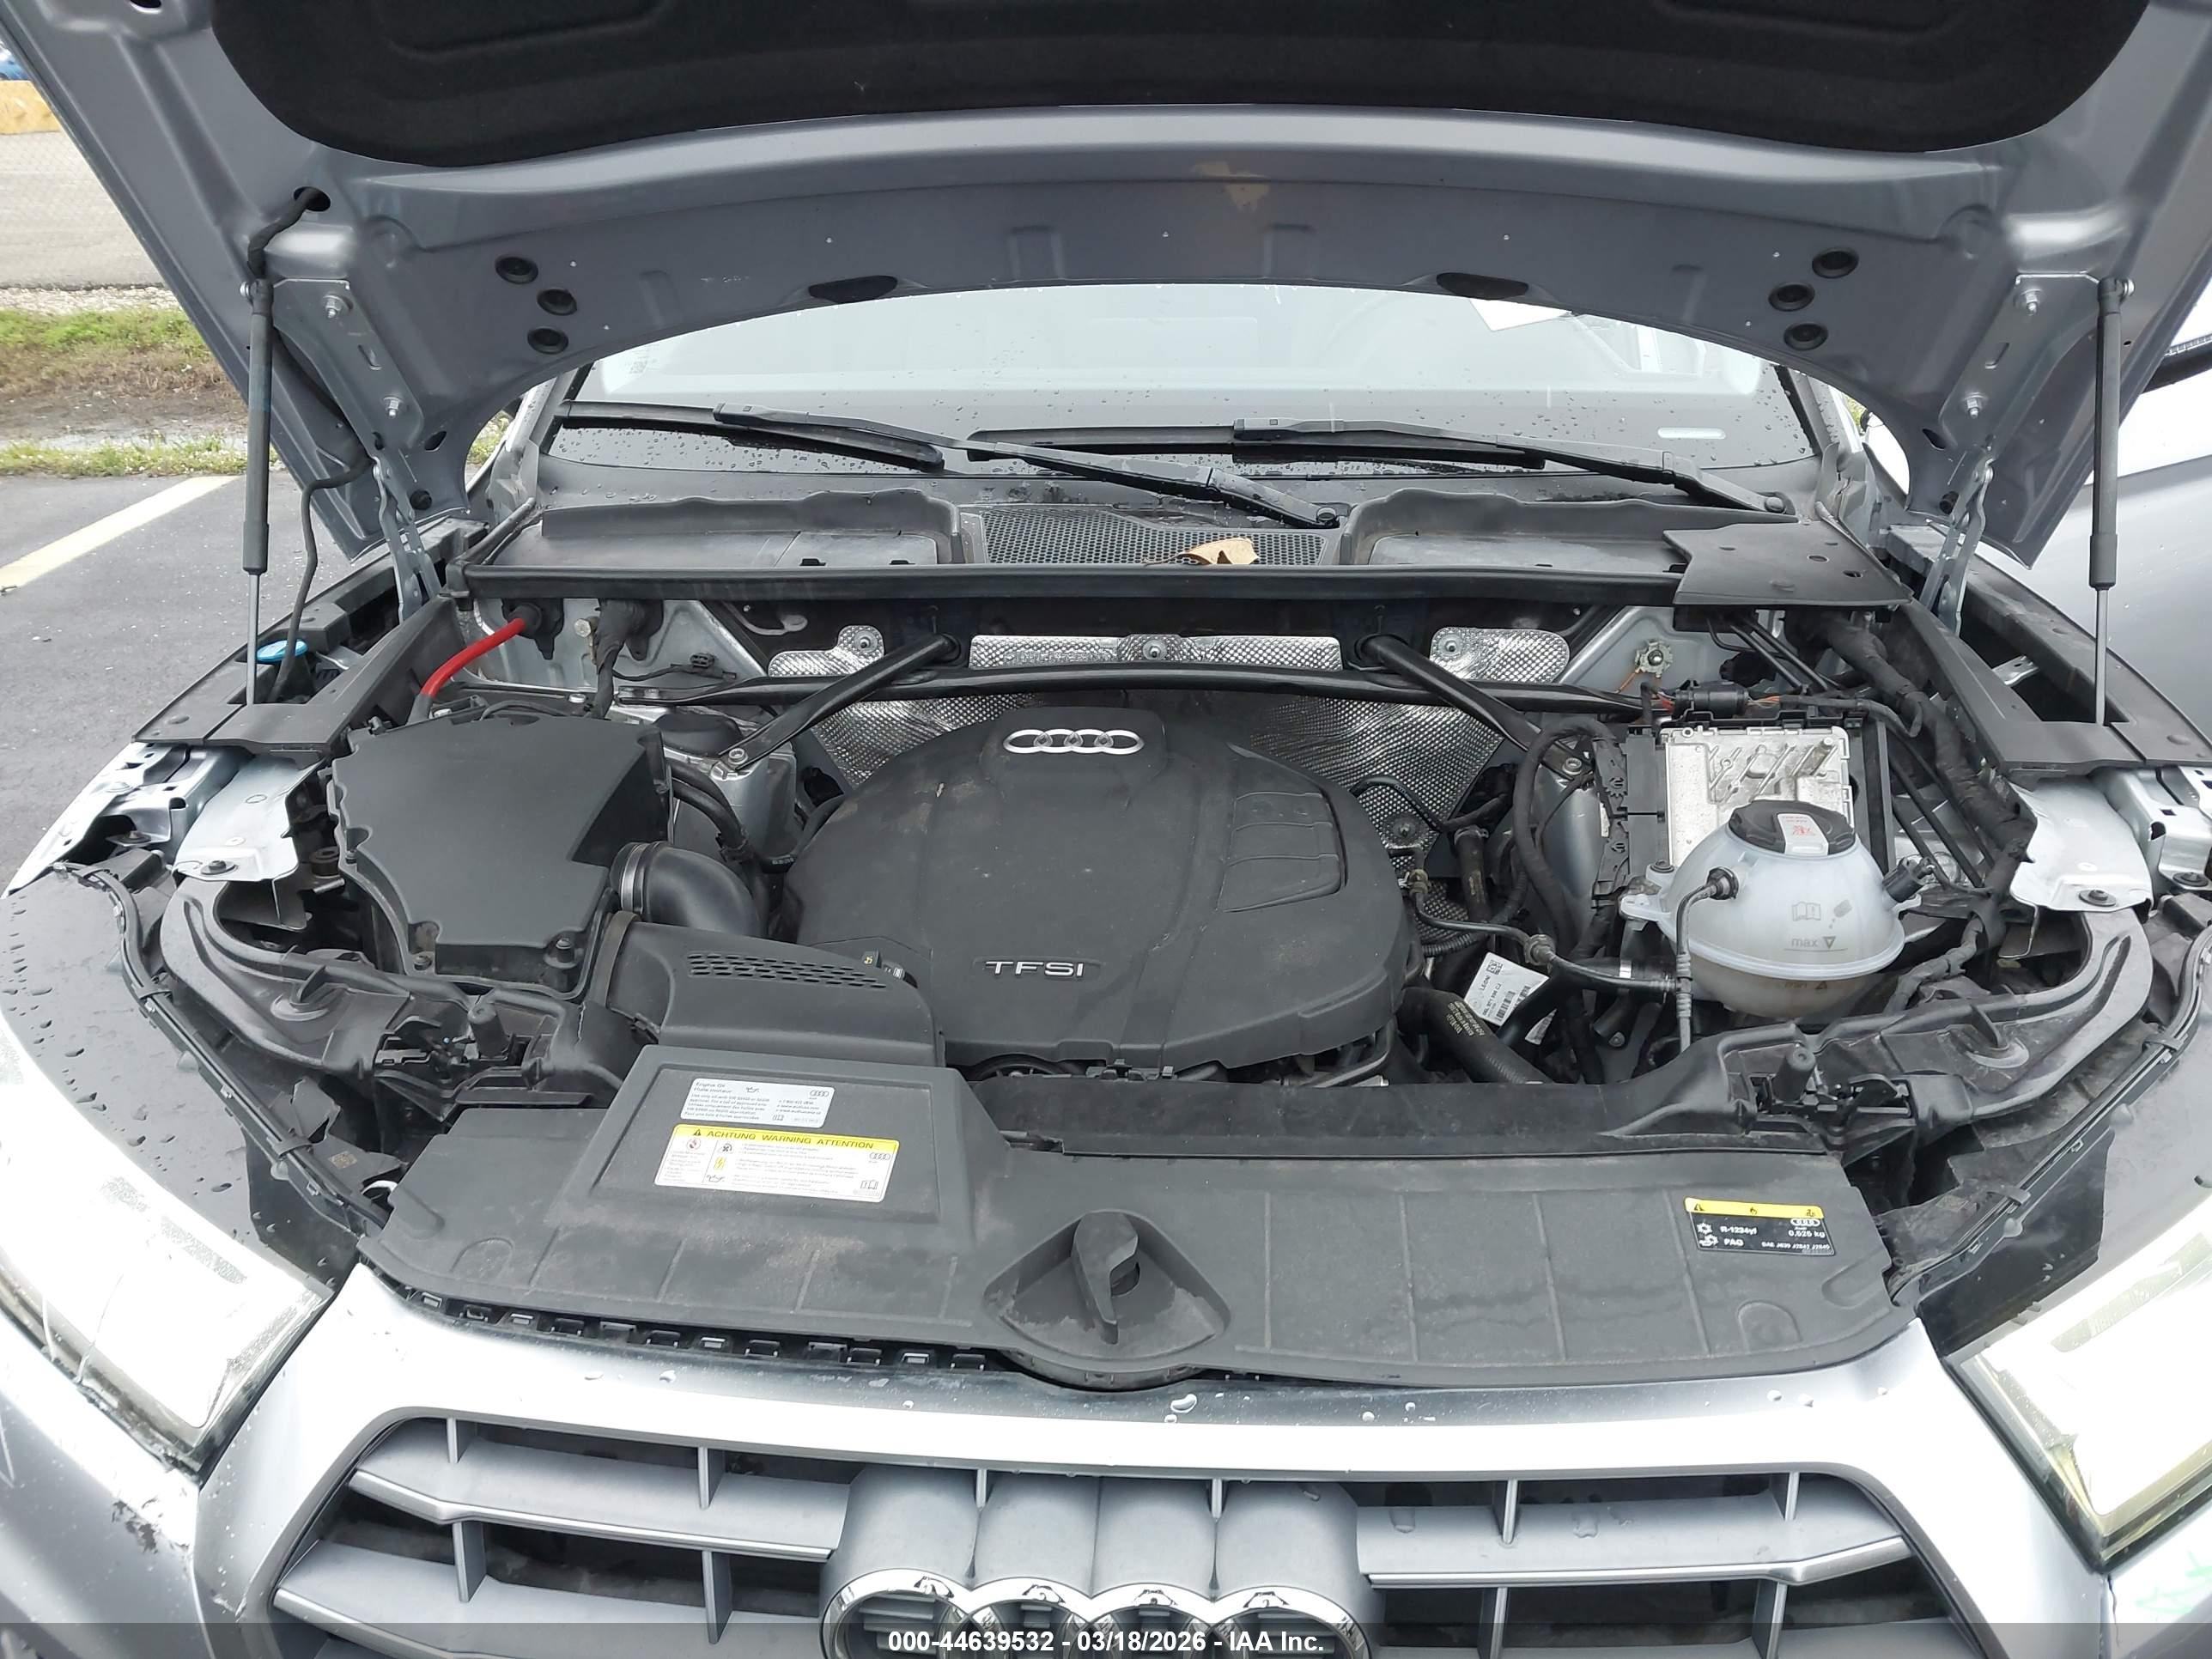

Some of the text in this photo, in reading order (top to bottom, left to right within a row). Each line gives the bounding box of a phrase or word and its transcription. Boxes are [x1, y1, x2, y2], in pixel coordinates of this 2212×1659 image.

[1791, 938, 1818, 948] max
[985, 961, 1085, 977] TFSI
[707, 1130, 874, 1150] ACHTUNG WARNING ATTENTION
[1814, 1231, 1826, 1239] kg
